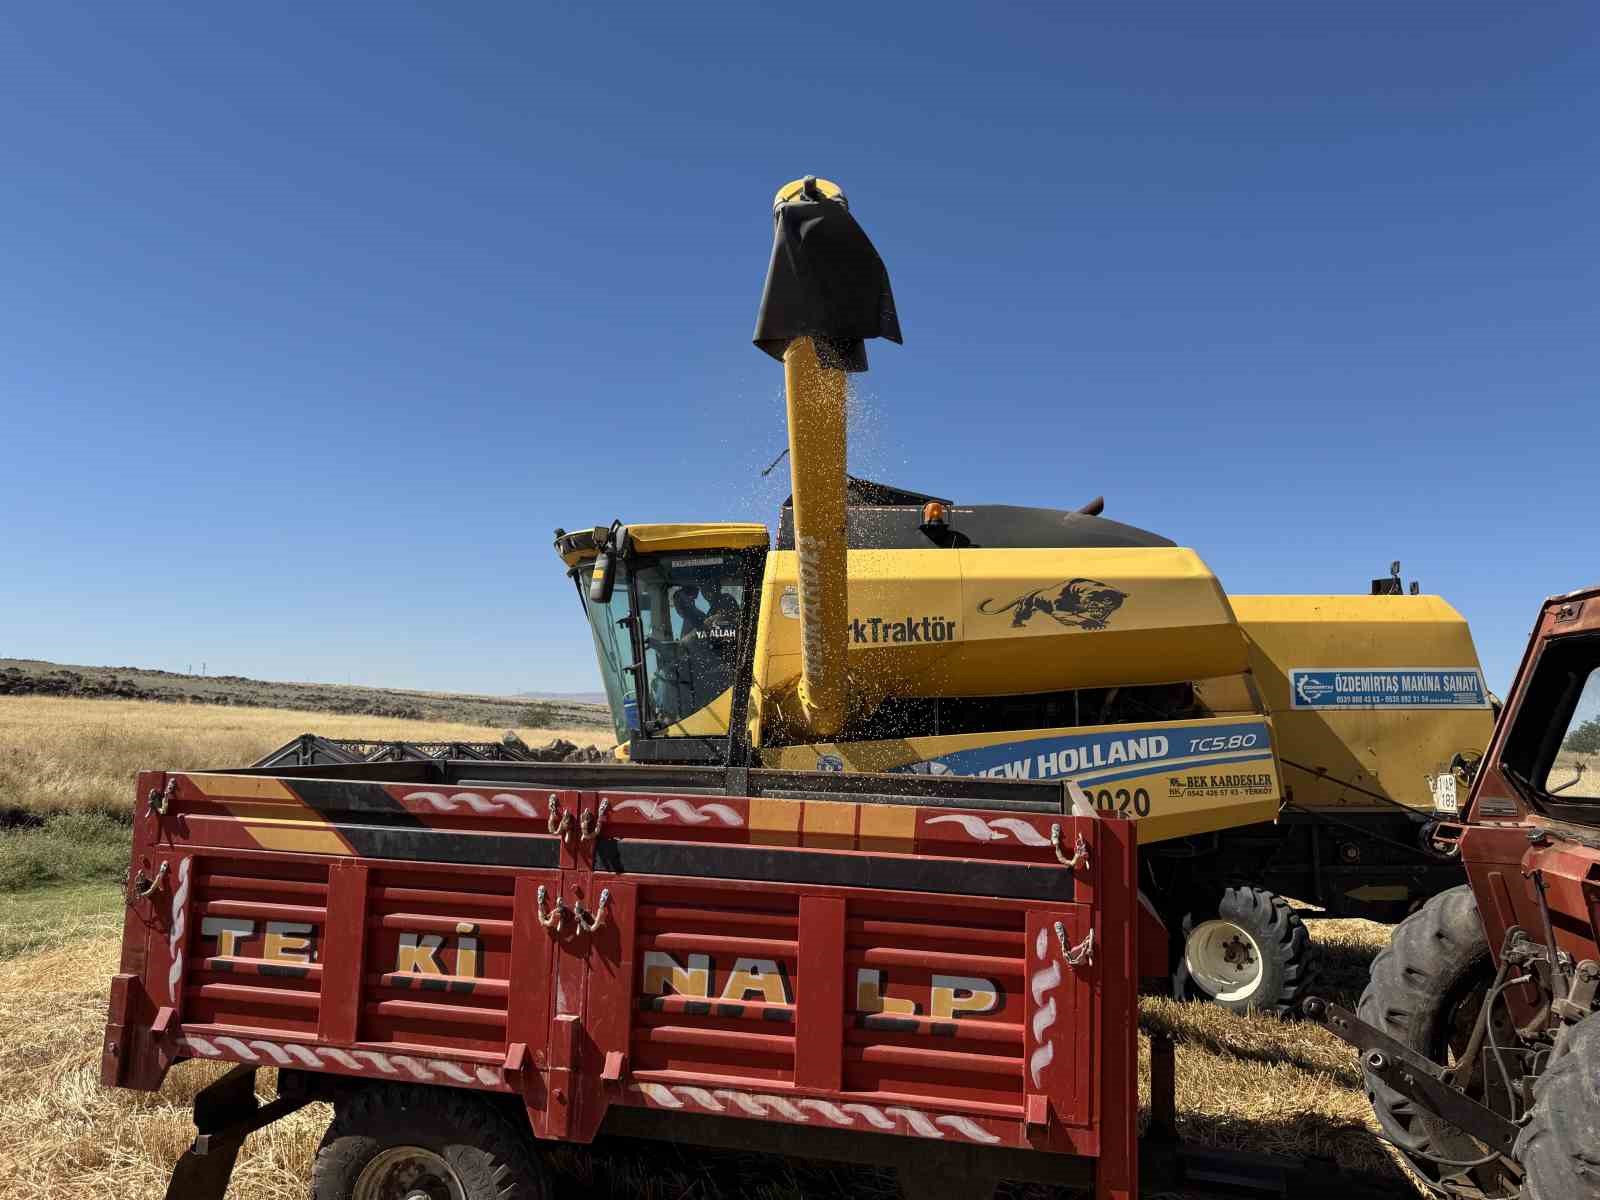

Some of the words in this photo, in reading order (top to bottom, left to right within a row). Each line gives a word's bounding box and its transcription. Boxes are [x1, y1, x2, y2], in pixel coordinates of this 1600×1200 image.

[709, 628, 736, 638] ALLAH
[1335, 673, 1399, 693] ÖZDEMİRTAŞ
[1401, 673, 1441, 692] MAKİNA
[1188, 734, 1257, 752] TC5.80
[1037, 735, 1169, 778] HOLLAND
